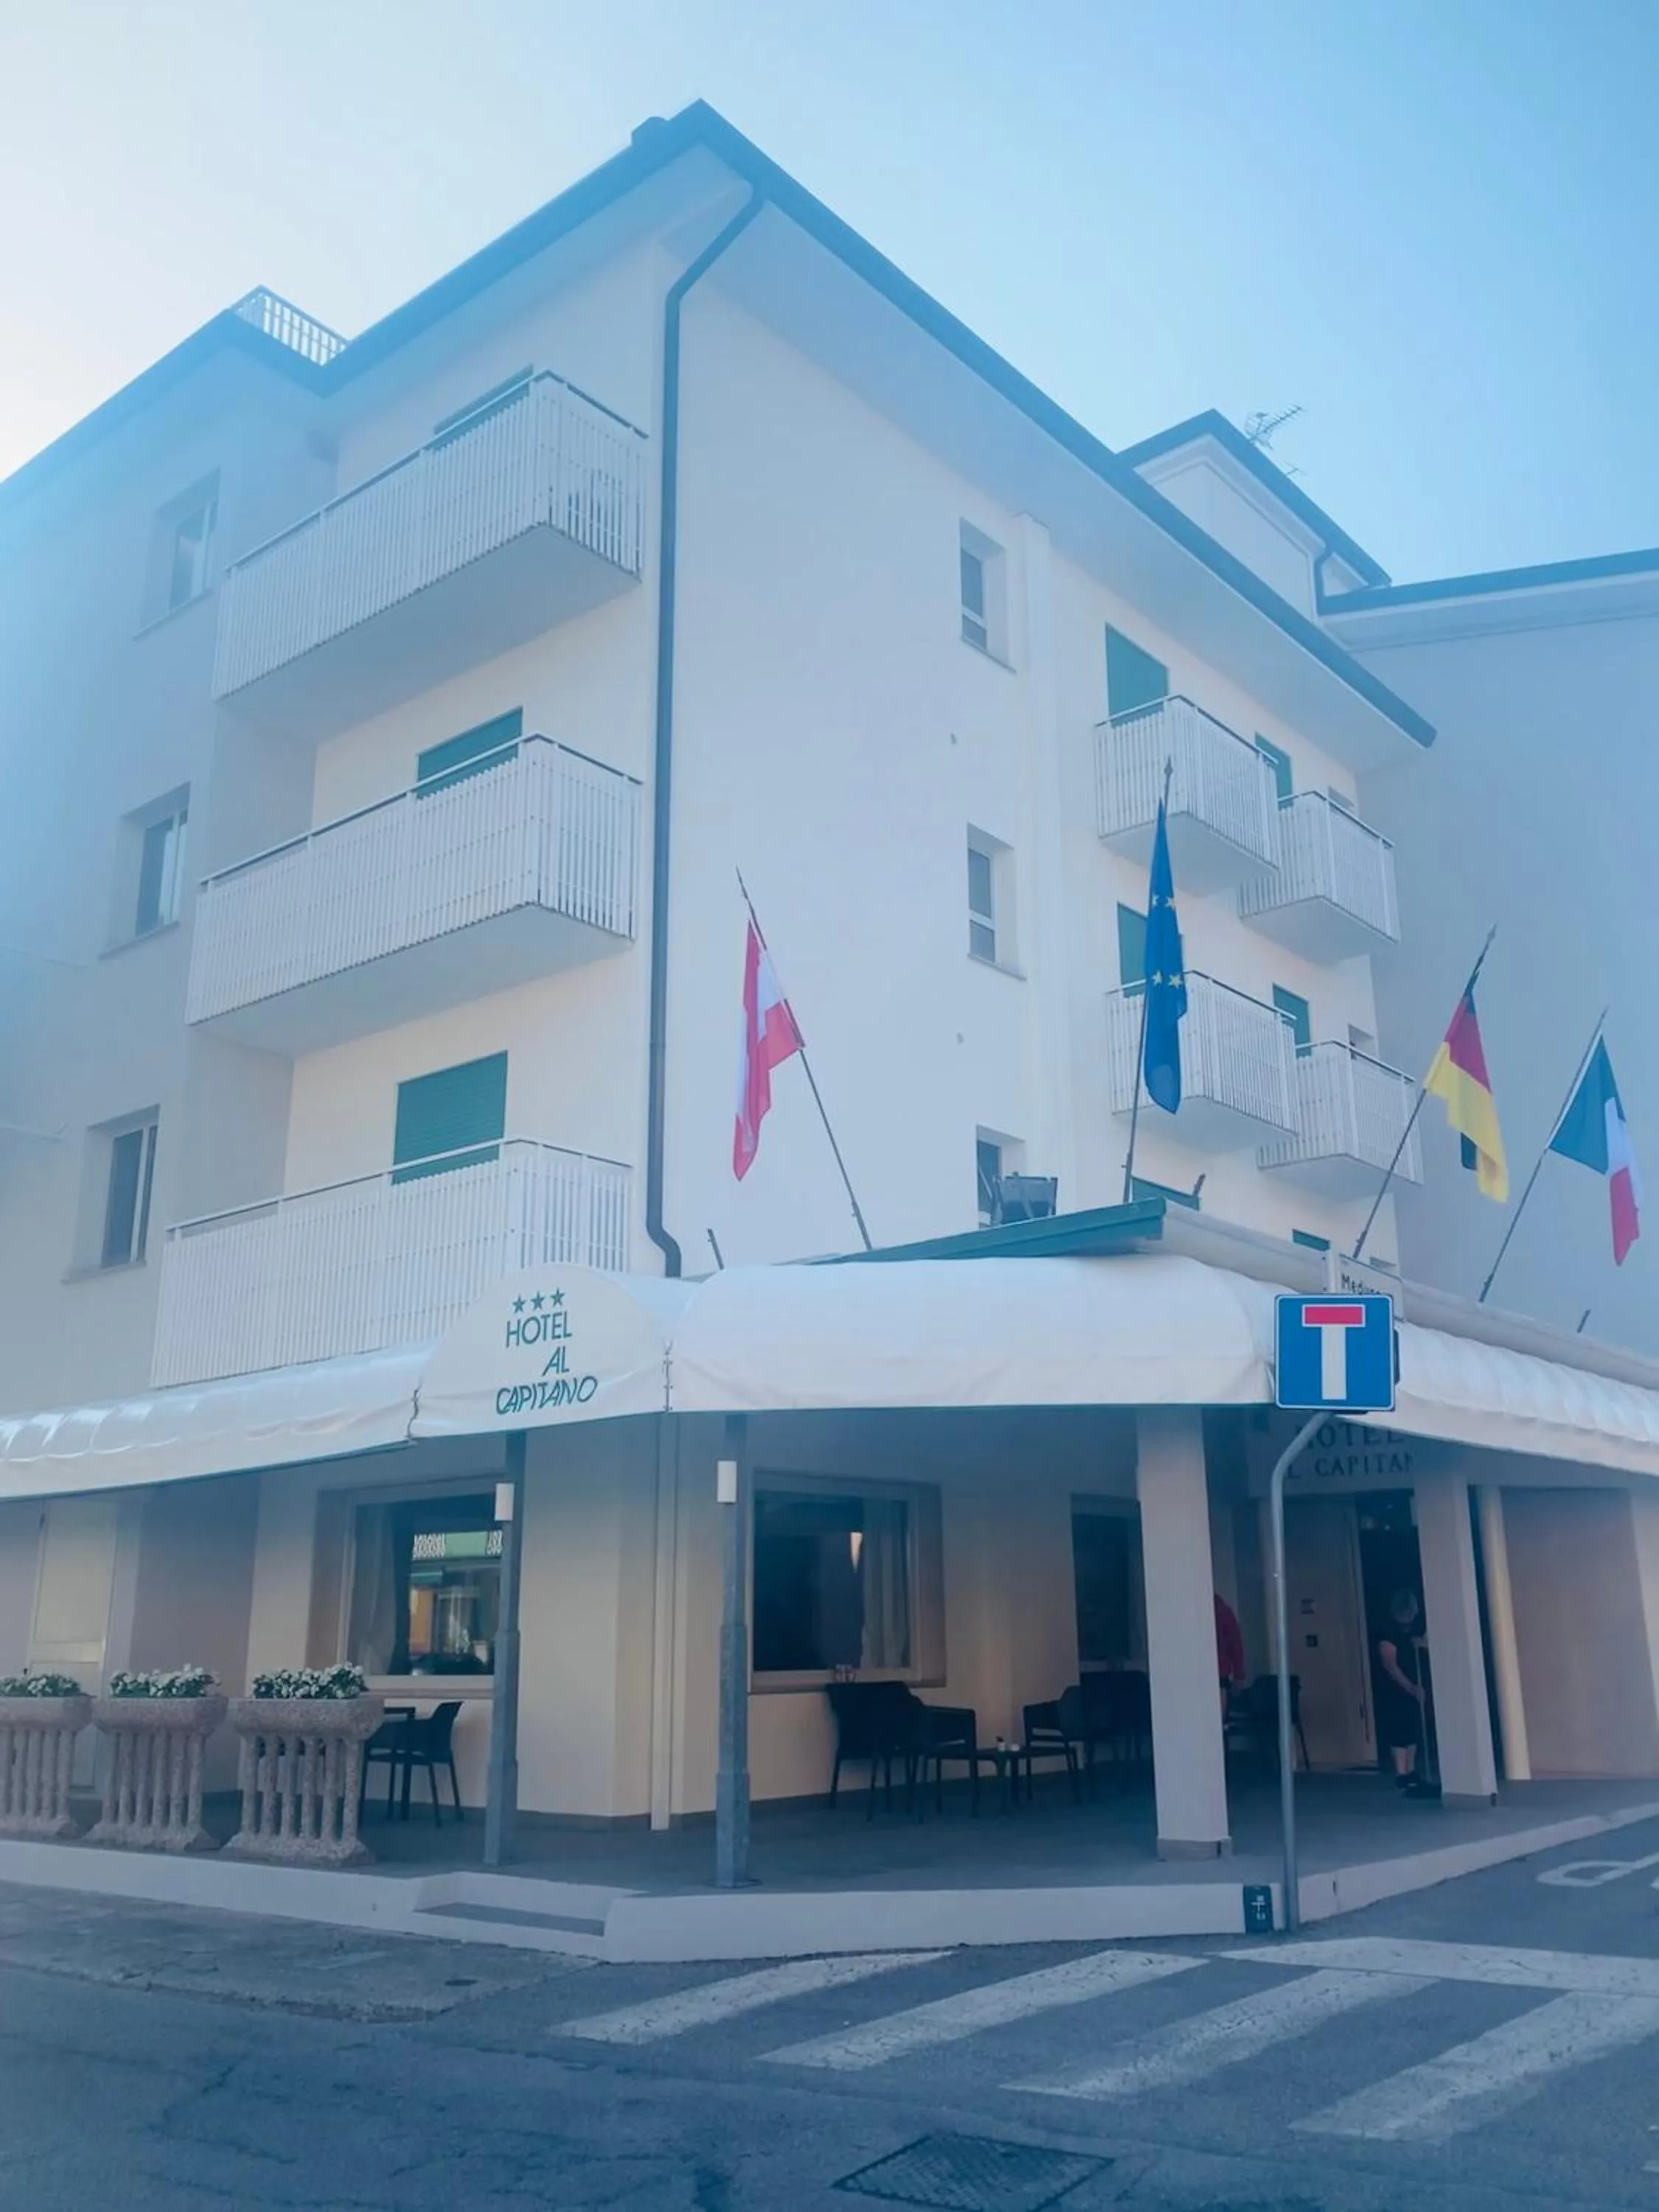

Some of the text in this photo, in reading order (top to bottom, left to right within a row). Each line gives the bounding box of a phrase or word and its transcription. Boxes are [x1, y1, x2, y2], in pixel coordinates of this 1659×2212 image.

[506, 1311, 572, 1348] HOTEL
[542, 1346, 570, 1376] AL
[496, 1376, 598, 1415] CAPITANO
